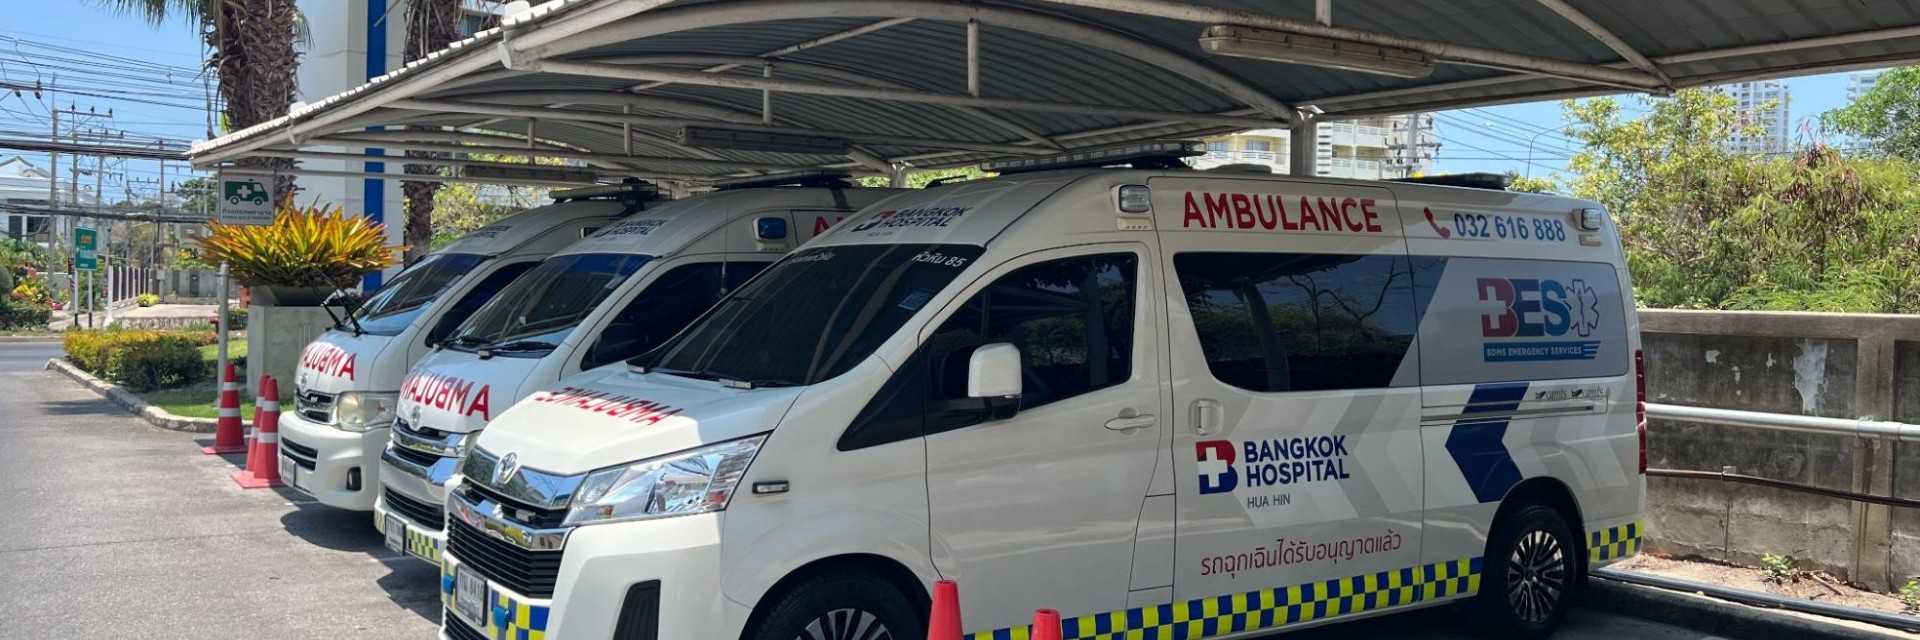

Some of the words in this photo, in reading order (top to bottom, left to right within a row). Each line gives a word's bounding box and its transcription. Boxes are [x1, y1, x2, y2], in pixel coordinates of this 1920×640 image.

[877, 216, 953, 228] HOSPITAL
[893, 206, 974, 219] BANGKOK
[1183, 191, 1383, 233] AMBULANCE
[1453, 213, 1491, 238] 032
[1494, 215, 1529, 240] 616
[1532, 218, 1566, 242] 888
[945, 256, 968, 267] 85
[1476, 278, 1571, 337] BES
[1486, 347, 1506, 357] BDMS
[1508, 347, 1549, 356] EMERGENCY
[1551, 346, 1582, 355] SERVICES
[1243, 434, 1349, 464] BANGKOK
[1245, 458, 1350, 488] HOSPITAL
[1247, 495, 1270, 509] HUA
[1273, 493, 1291, 506] HIN
[1201, 528, 1402, 579] รถฉุกเฉินได้รับอนุญาตแล้ว
